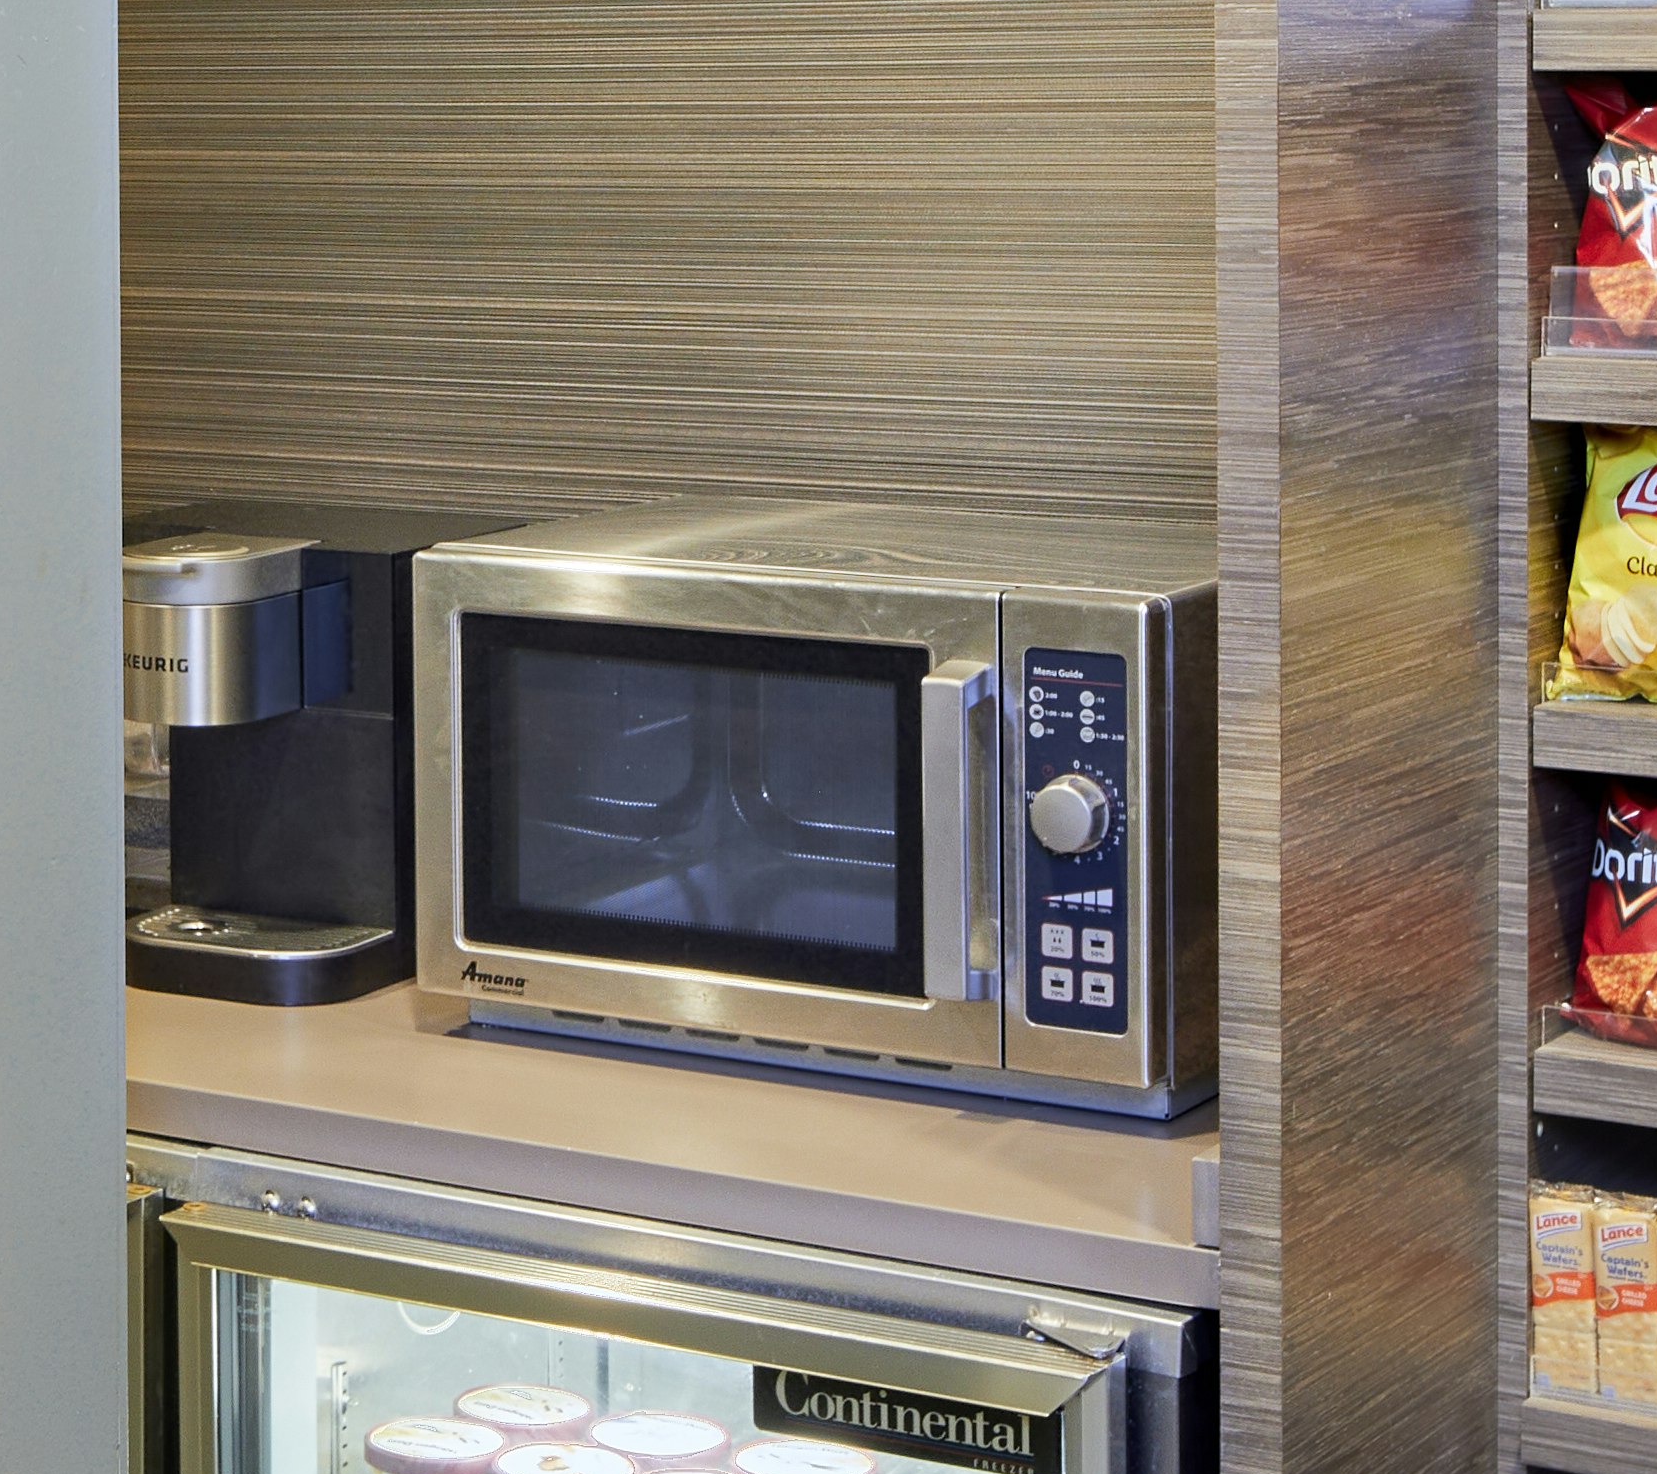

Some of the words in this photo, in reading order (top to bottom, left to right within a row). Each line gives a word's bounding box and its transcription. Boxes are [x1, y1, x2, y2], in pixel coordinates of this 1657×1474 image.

[124, 653, 189, 672] KEURIG
[1033, 667, 1057, 676] Menu
[1058, 669, 1084, 679] Guide
[1073, 760, 1080, 769] 0
[1026, 791, 1036, 800] 10
[1113, 788, 1118, 797] 1
[1113, 836, 1119, 845] 2
[1074, 856, 1080, 864] 4
[1097, 852, 1103, 861] 3
[461, 961, 525, 987] Amana
[1536, 1214, 1577, 1230] Lance
[1600, 1226, 1644, 1242] Lance
[1600, 1253, 1649, 1269] Captain's
[775, 1370, 1034, 1457] Continental
